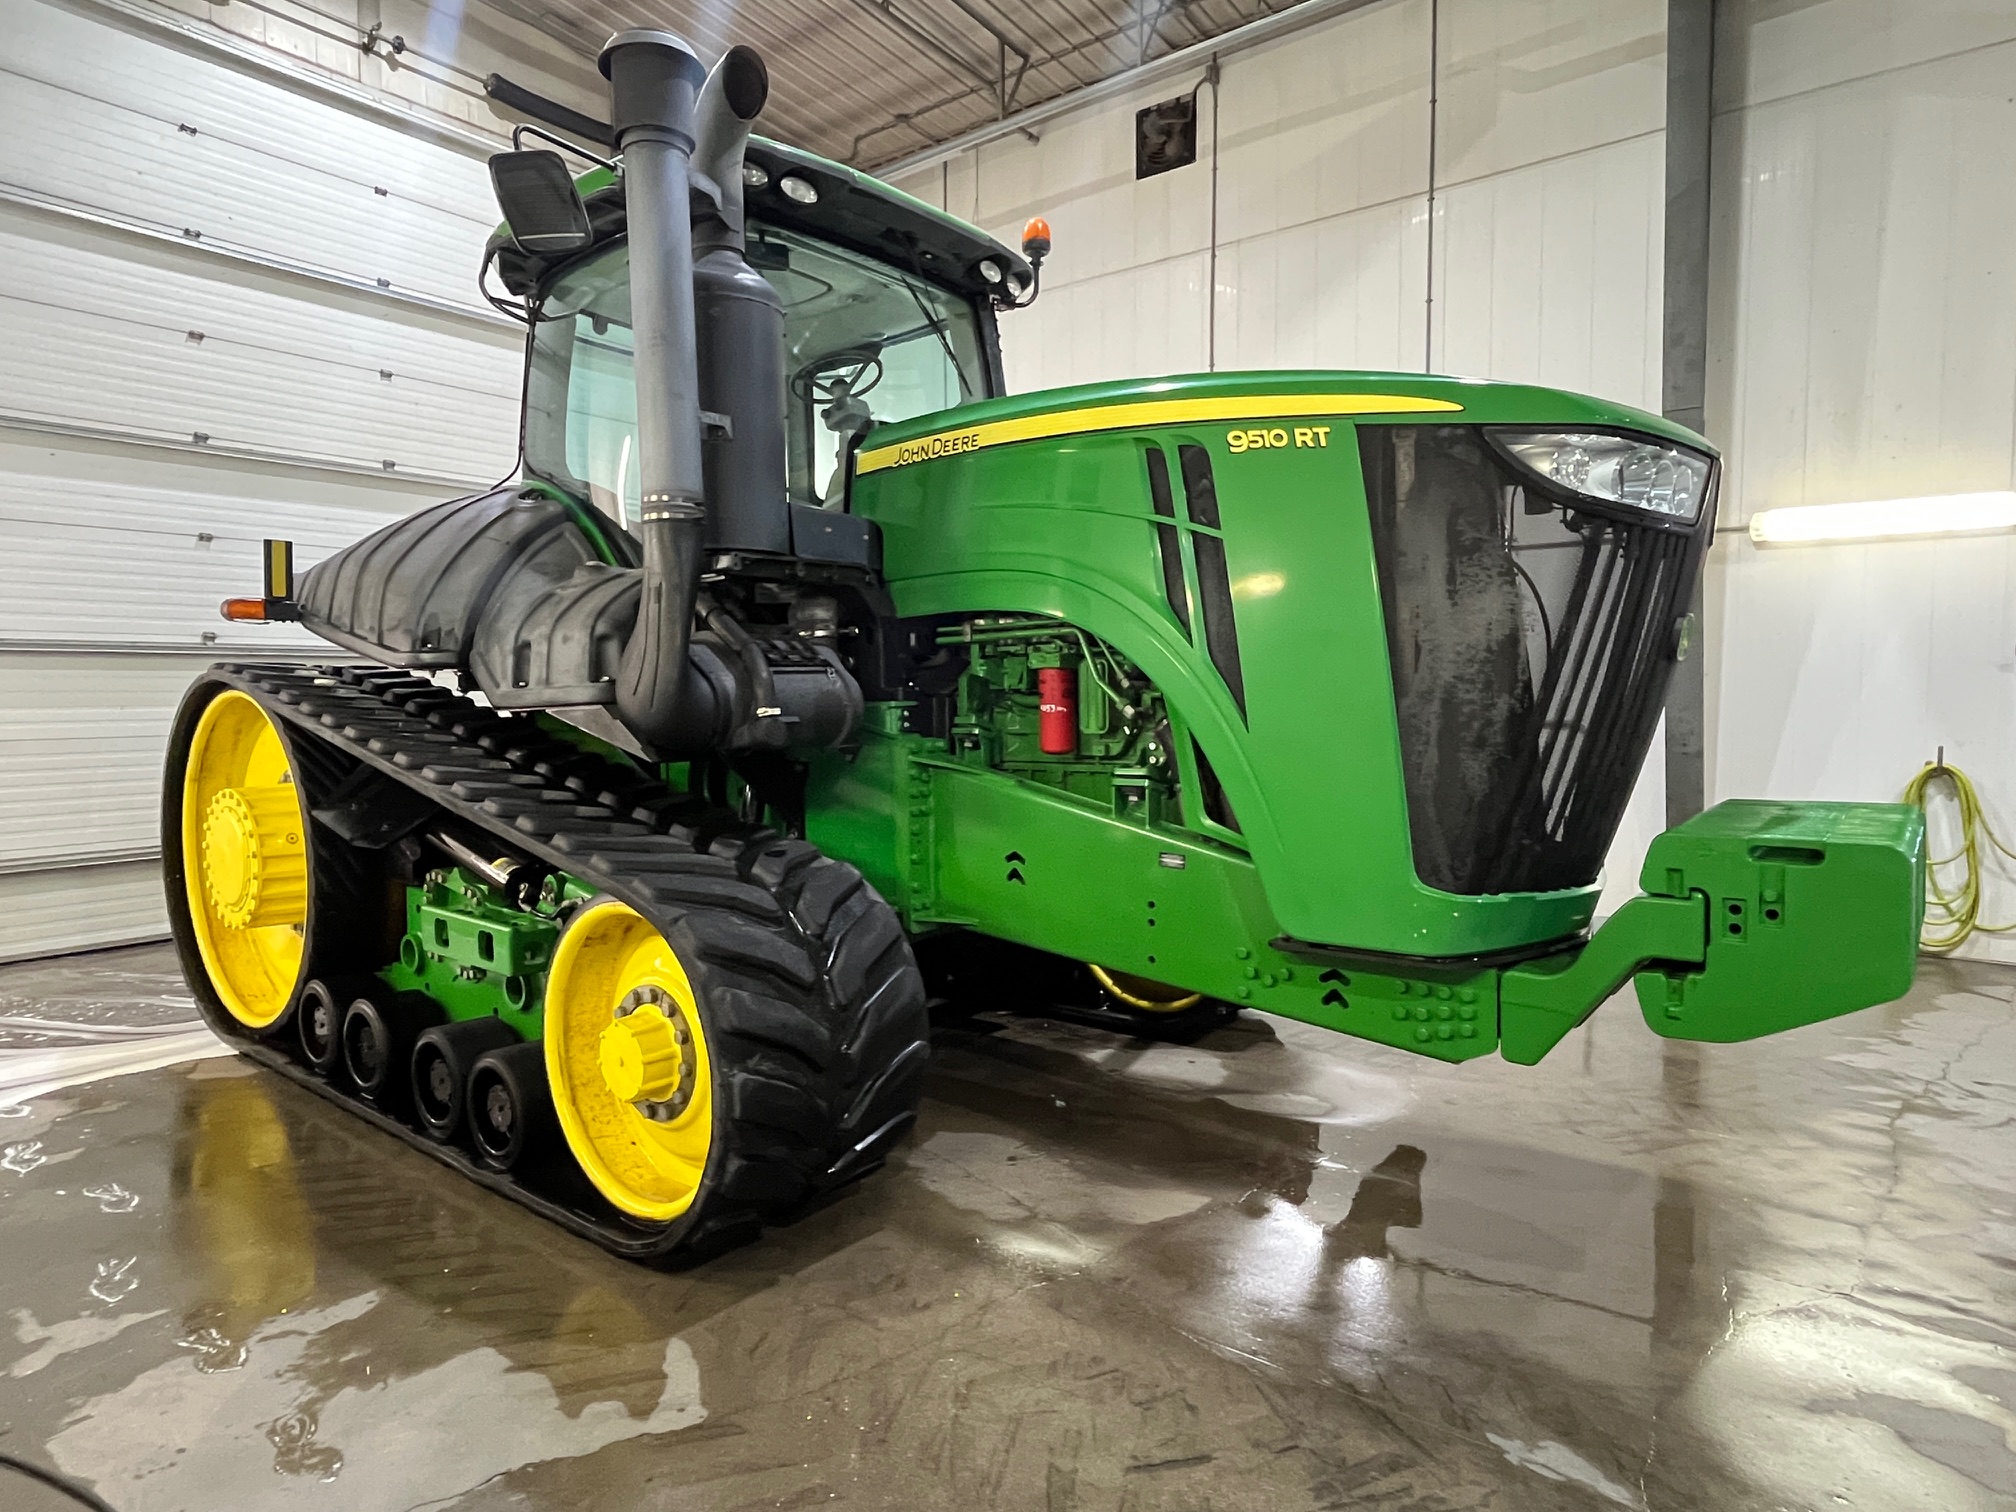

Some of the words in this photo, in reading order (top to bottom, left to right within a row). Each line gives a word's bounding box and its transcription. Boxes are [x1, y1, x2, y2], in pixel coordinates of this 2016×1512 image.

[894, 443, 930, 465] JOHN
[931, 433, 980, 456] DEERE
[1226, 428, 1289, 454] 9510
[1293, 426, 1331, 448] RT
